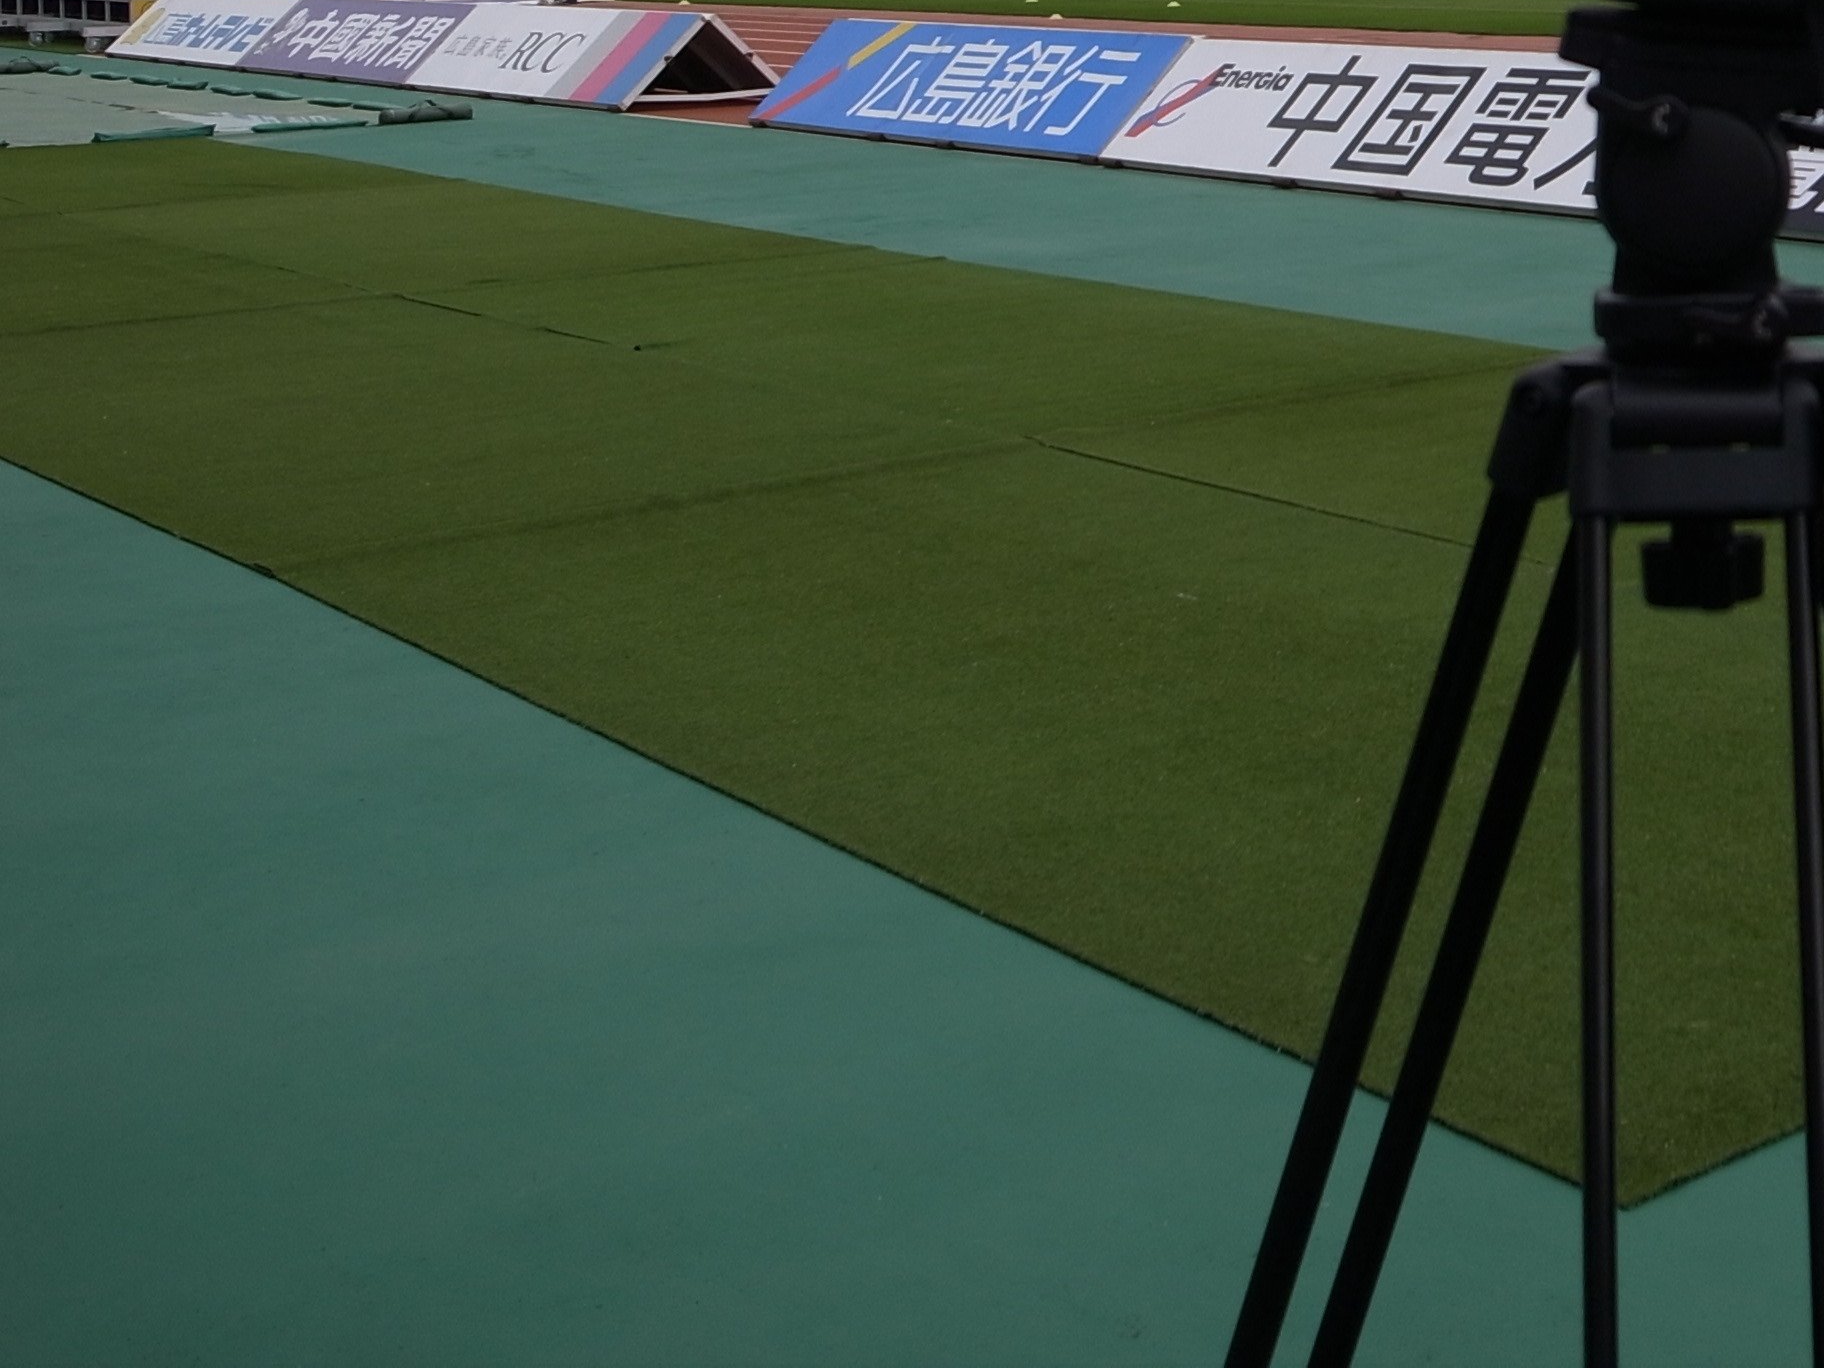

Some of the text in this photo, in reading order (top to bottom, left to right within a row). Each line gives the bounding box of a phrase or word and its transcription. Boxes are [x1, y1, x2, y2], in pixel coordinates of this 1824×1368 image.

[498, 32, 586, 73] RCC
[846, 36, 1142, 136] 広島銀行
[1212, 62, 1295, 92] Energia
